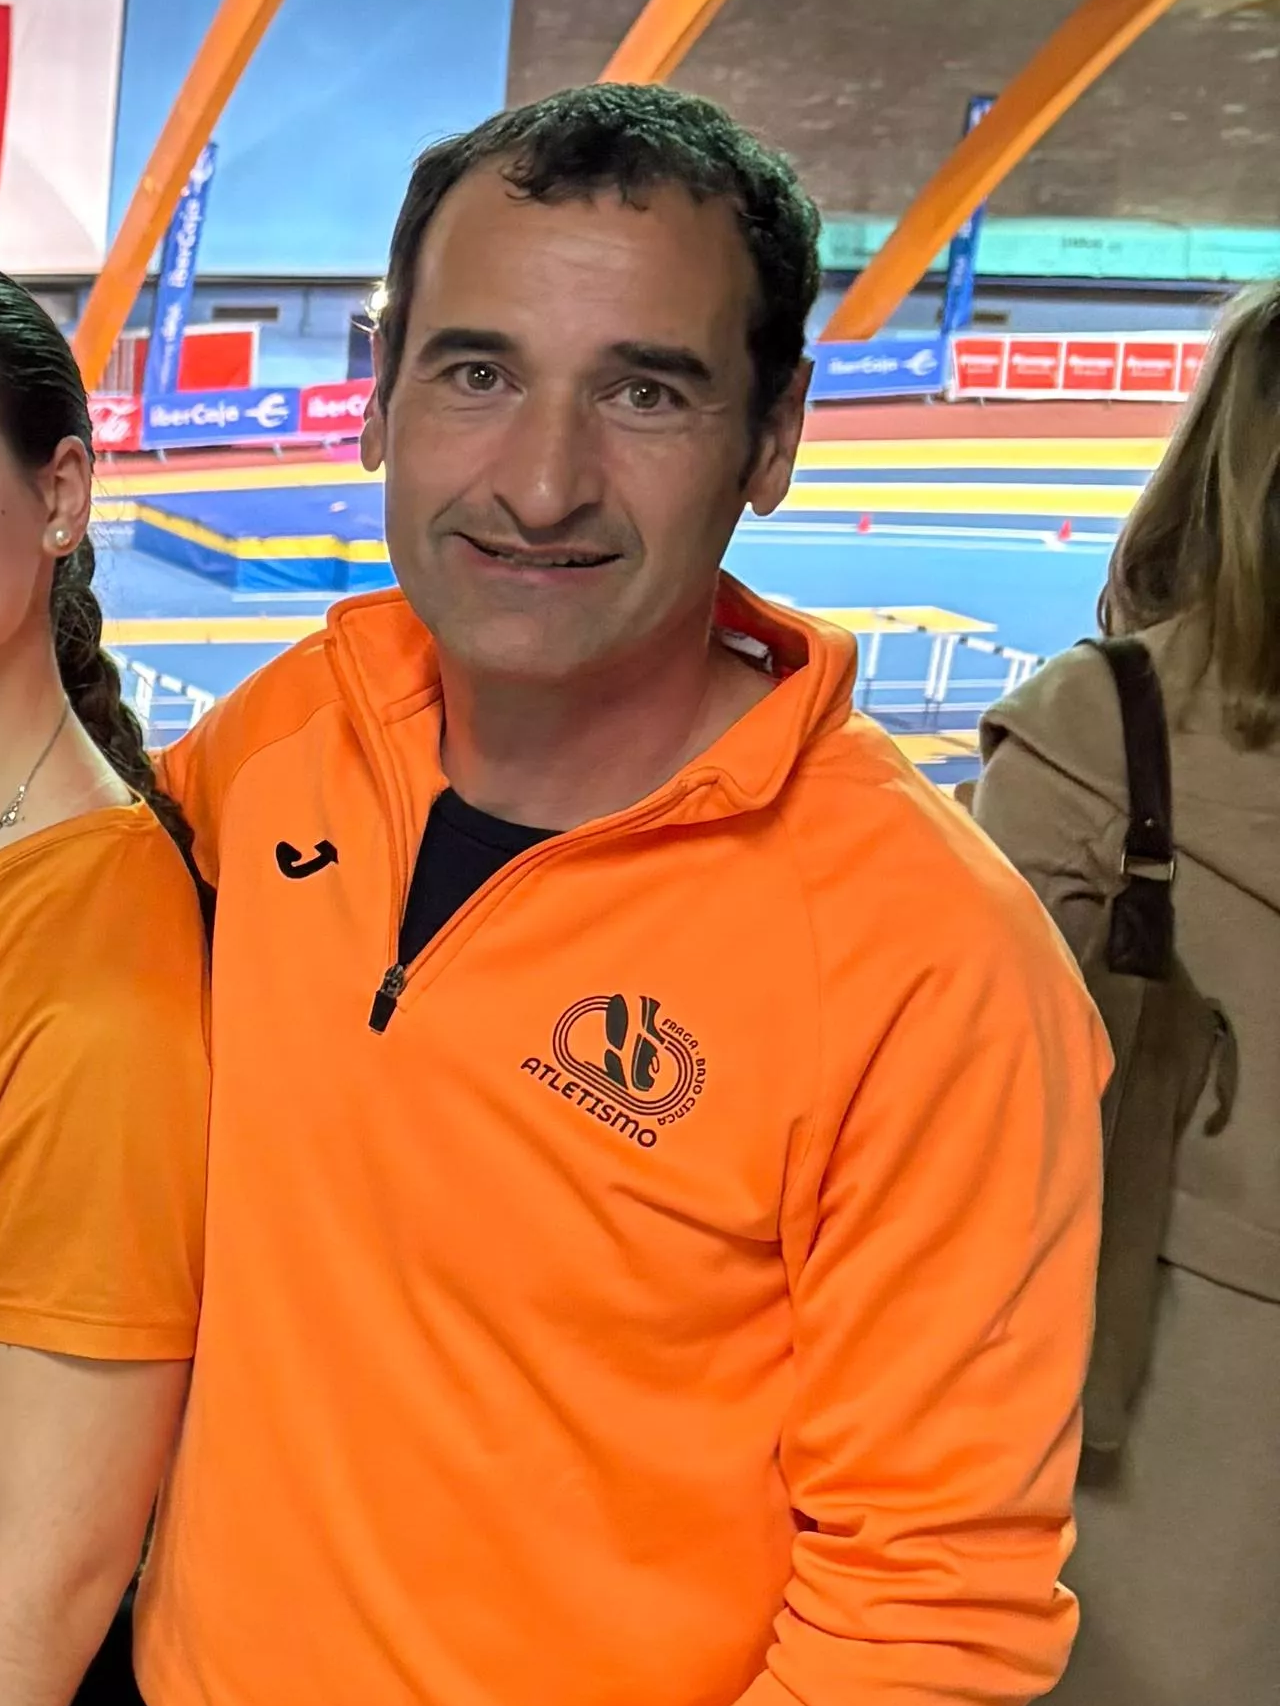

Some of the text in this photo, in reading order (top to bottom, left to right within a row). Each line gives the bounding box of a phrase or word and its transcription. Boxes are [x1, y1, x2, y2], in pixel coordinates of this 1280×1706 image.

[520, 1057, 657, 1148] ATLETISMO
[657, 1018, 707, 1126] FRAGA BAJO CINCA
